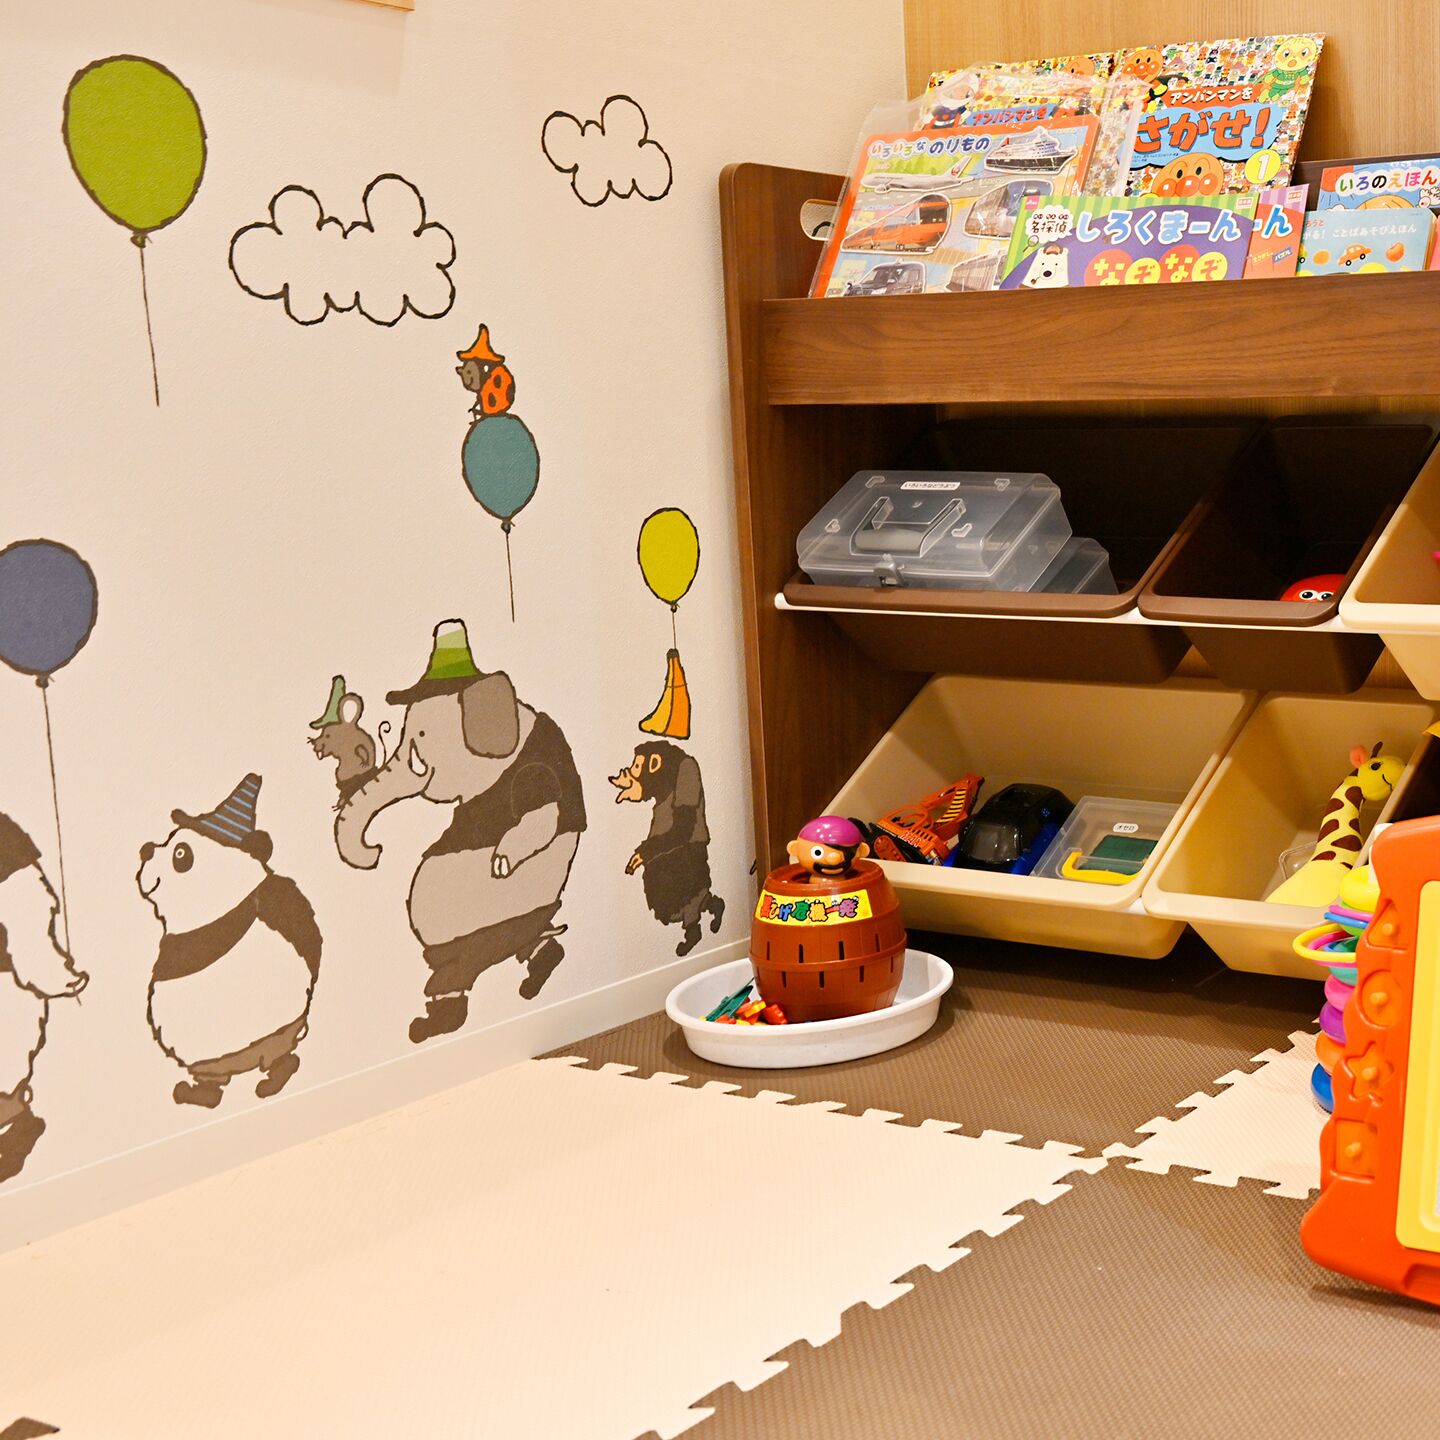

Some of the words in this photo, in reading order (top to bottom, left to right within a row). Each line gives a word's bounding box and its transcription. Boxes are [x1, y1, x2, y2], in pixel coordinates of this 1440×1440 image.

[1134, 107, 1270, 152] さがせ!
[1257, 154, 1270, 180] 1
[1339, 169, 1438, 191] いろのえほん
[1031, 221, 1067, 233] 名探偵
[1075, 209, 1242, 245] しろくまーん
